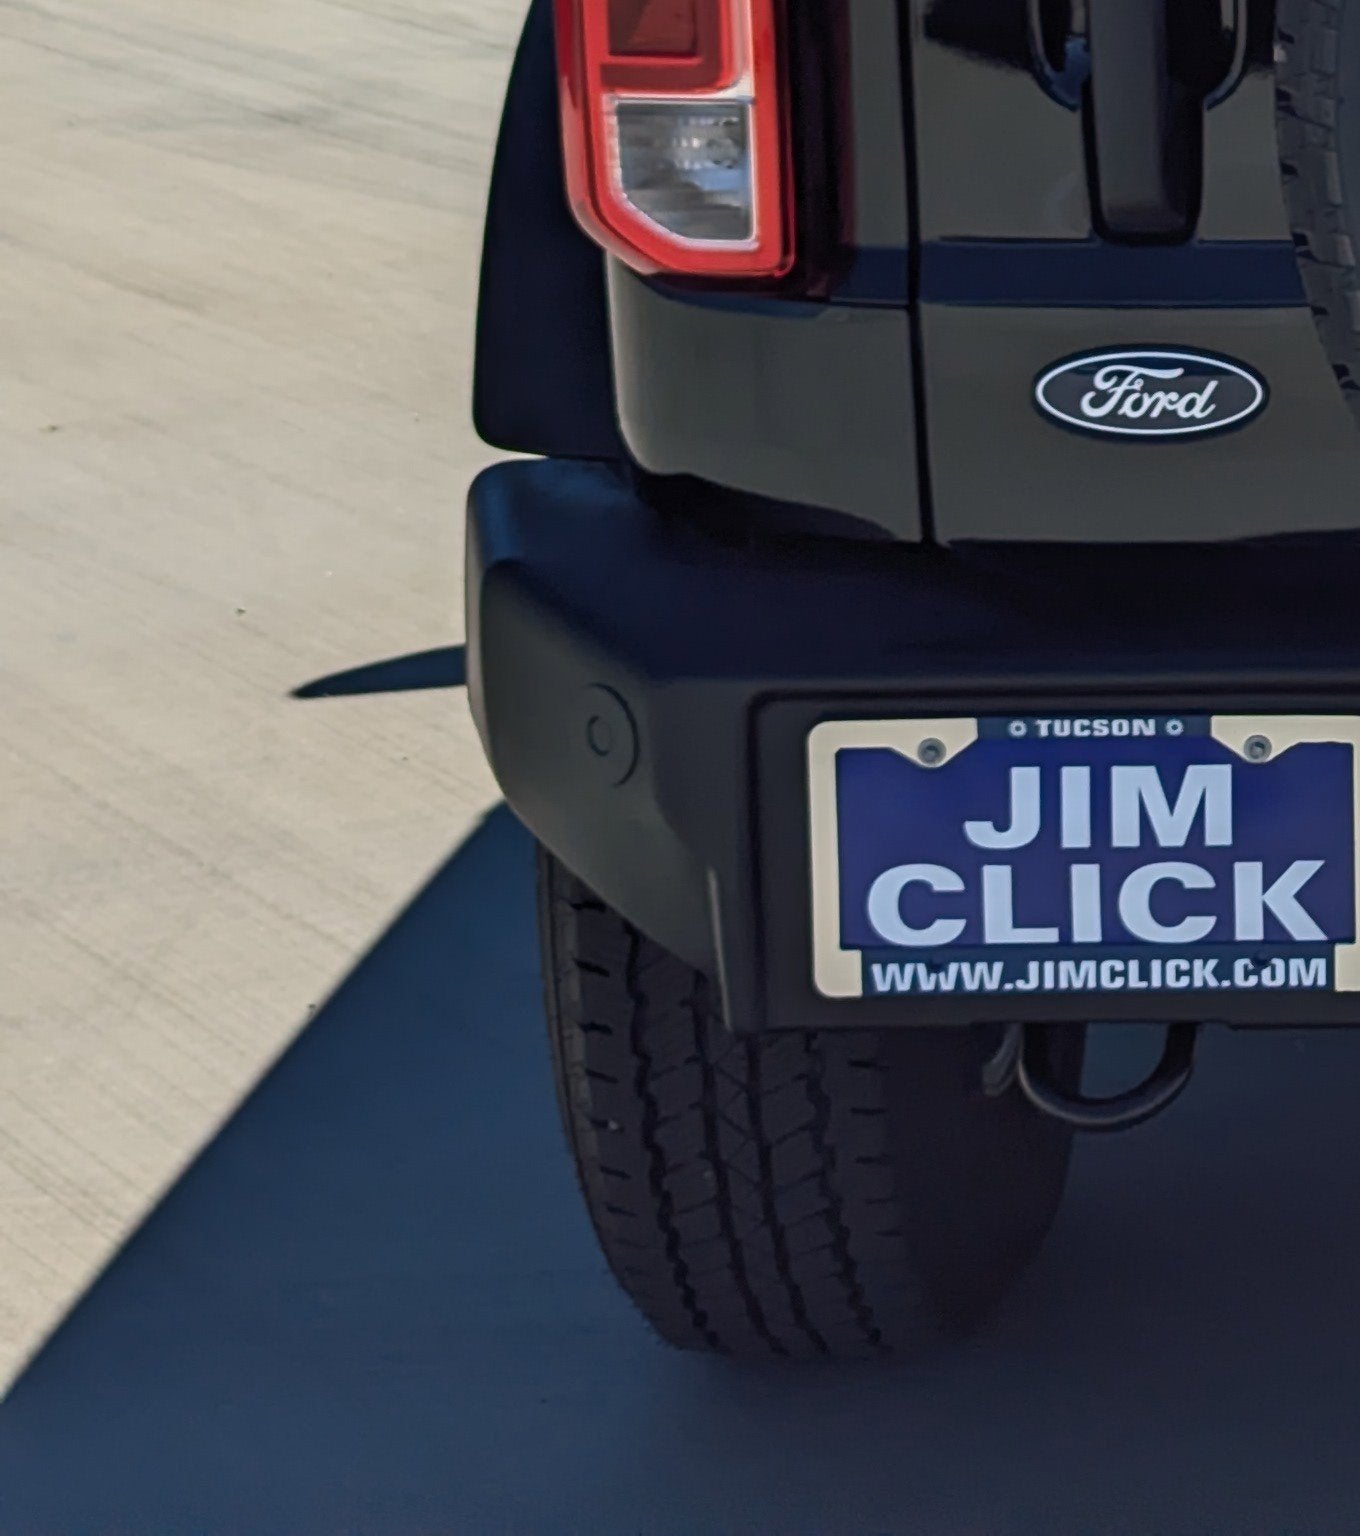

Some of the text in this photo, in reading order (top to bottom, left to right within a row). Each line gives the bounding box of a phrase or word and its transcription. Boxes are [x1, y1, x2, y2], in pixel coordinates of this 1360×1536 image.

[1080, 364, 1219, 419] Ford
[1036, 719, 1156, 737] TUCSON
[964, 764, 1233, 850] JIM
[867, 860, 1329, 946] CLICK
[871, 959, 1328, 991] WWW.JIMCLICK.COM
